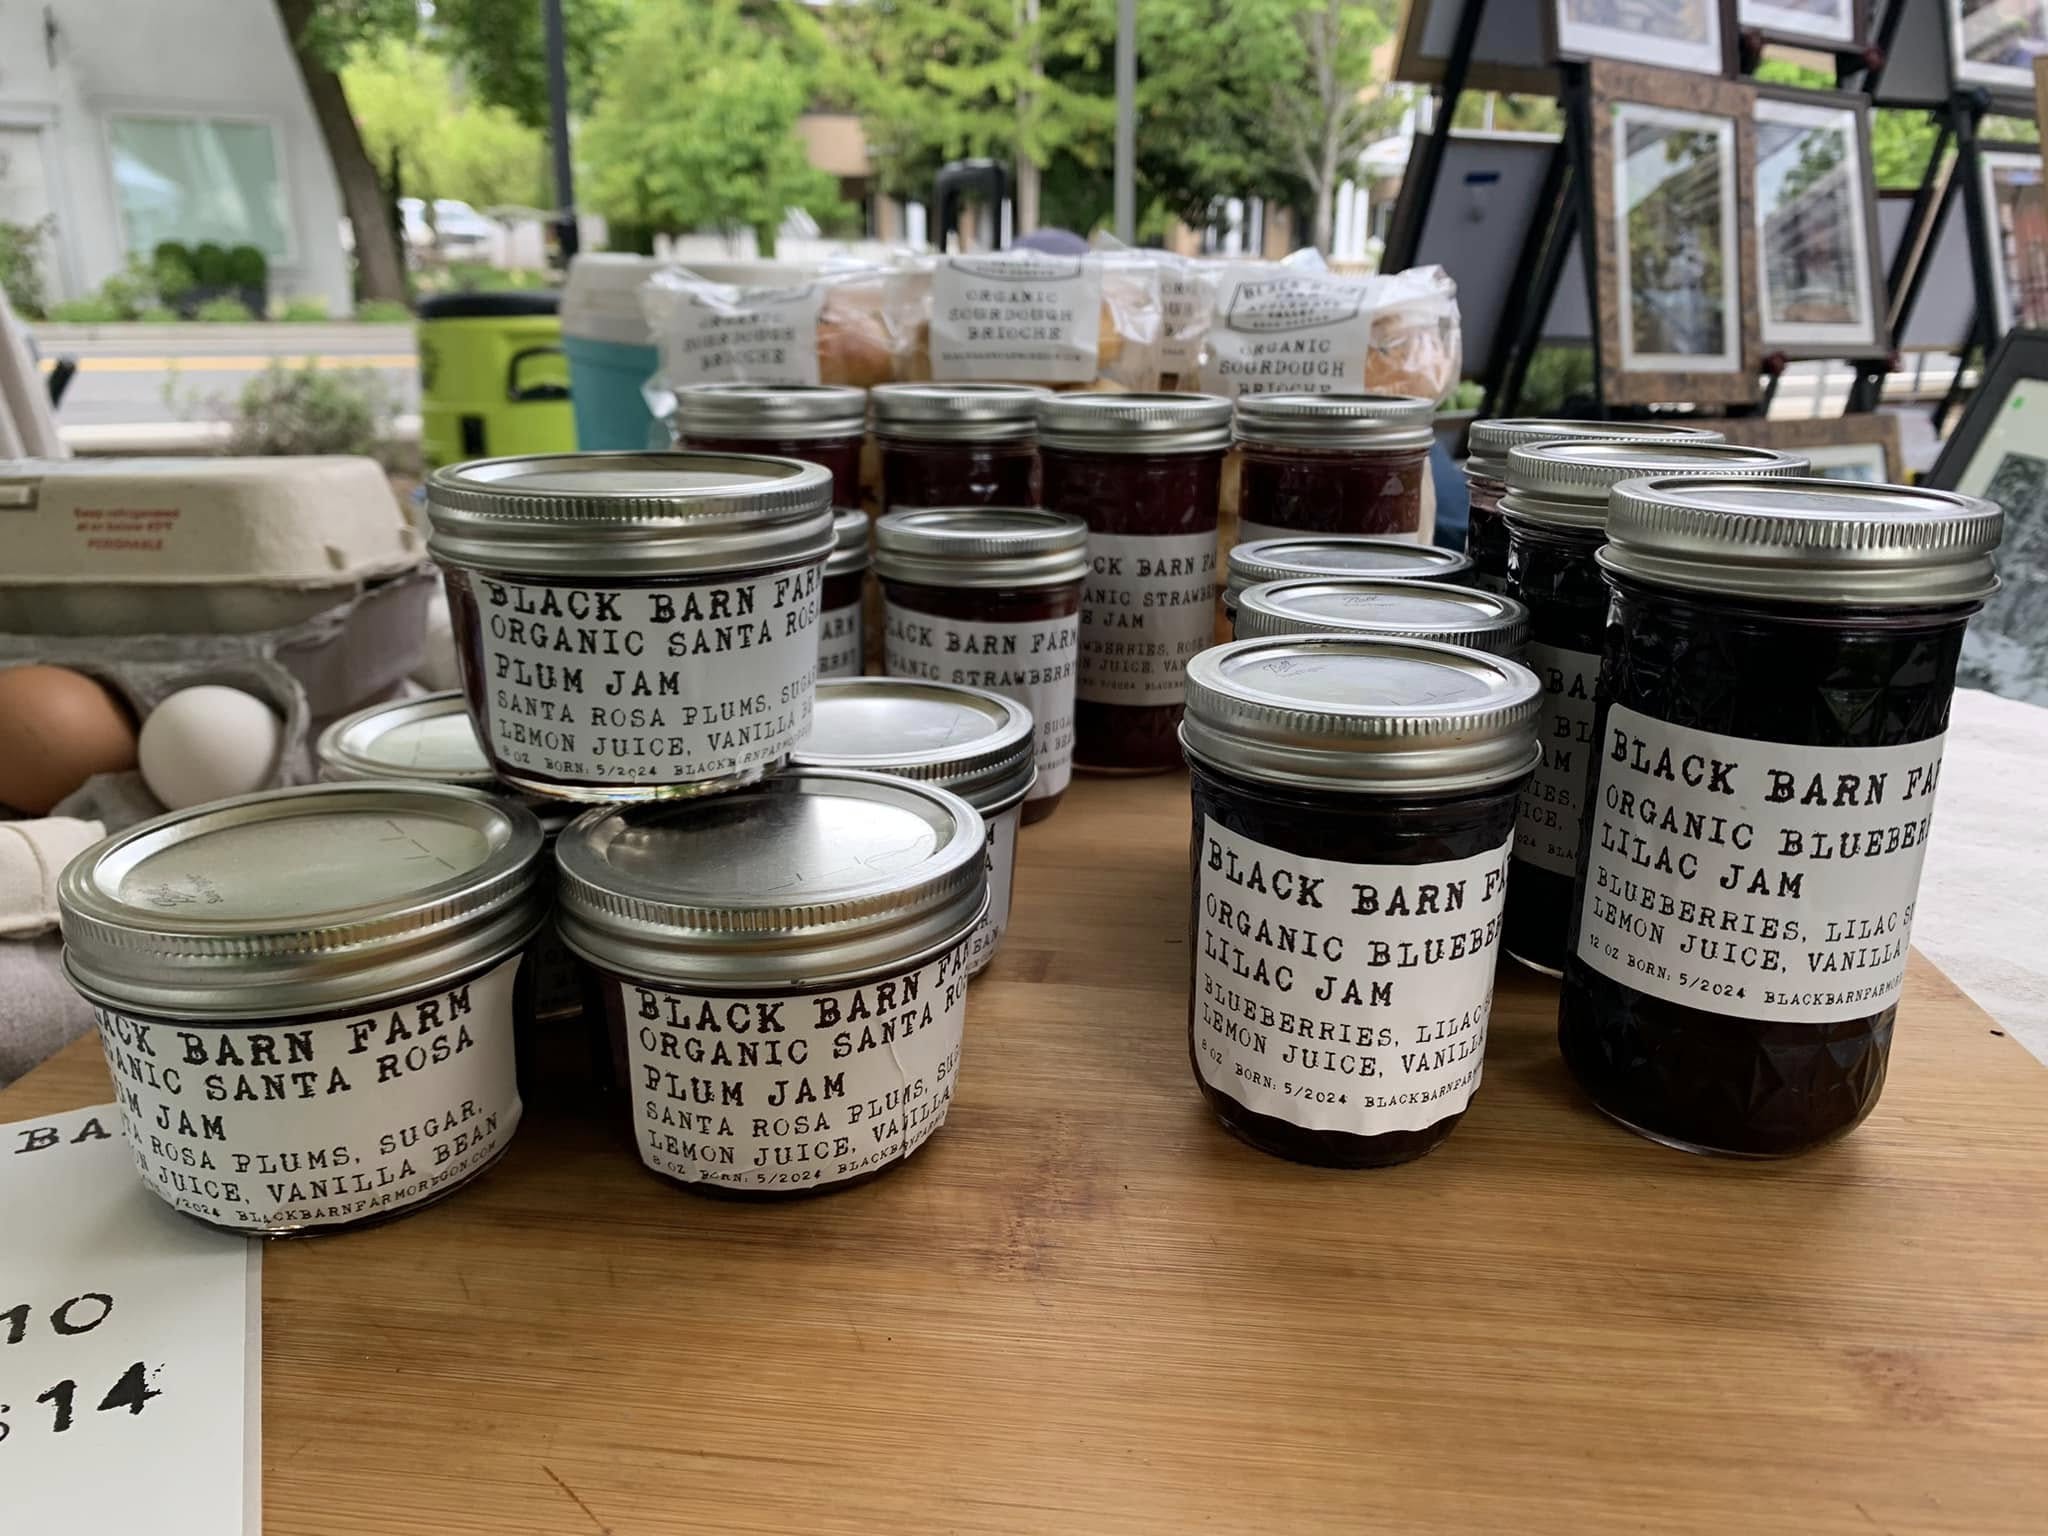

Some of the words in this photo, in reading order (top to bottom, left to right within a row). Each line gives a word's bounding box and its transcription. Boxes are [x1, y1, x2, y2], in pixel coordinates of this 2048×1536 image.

[1136, 557, 1195, 577] BARN
[480, 579, 622, 622] BLACK
[649, 585, 756, 624] BARN
[1103, 613, 1144, 628] JAM
[491, 614, 644, 656] ORGANIC
[668, 619, 772, 657] SANTA
[945, 631, 1017, 655] BARN
[495, 653, 584, 694] PLUM
[605, 670, 681, 696] JAM
[498, 690, 575, 724] SANTA
[591, 707, 666, 727] ROSA
[499, 719, 576, 752] LEMON
[592, 737, 692, 757] JUICE,
[708, 710, 795, 751] VANILLA
[513, 751, 531, 765] OZ
[597, 764, 658, 777] 5/2024
[1611, 728, 1738, 796] BLACK
[1765, 769, 1888, 806] BARN
[1607, 783, 1755, 851] ORGANIC
[1208, 837, 1324, 909] BLACK
[1351, 880, 1466, 917] BARN
[1601, 822, 1699, 880] LILAC
[1719, 864, 1804, 899] JAM
[1206, 892, 1344, 962] ORGANIC
[1597, 865, 1807, 944] BLUEBERRIES,
[1825, 912, 1897, 944] LILAC
[1593, 896, 1665, 946] LEMON
[1680, 934, 1788, 975] JUICE,
[1808, 943, 1902, 974] VANILLA
[1204, 930, 1293, 992] LILAC
[1315, 975, 1394, 1007] JAM
[1589, 934, 1600, 950] 12
[1604, 946, 1620, 960] OZ
[1627, 953, 1672, 982] BORN:
[1679, 972, 1746, 999] 5/2024
[178, 1031, 314, 1066] BARN
[346, 984, 473, 1055] FARM
[635, 986, 786, 1034] BLACK
[814, 971, 921, 1030] BARN
[1204, 973, 1400, 1048] BLUEBERRIES,
[1415, 1004, 1482, 1044] LILAC
[205, 1067, 351, 1102] SANTA
[377, 1025, 474, 1083] ROSA
[640, 1027, 809, 1067] ORGANIC
[832, 1009, 934, 1060] SANTA
[1201, 1002, 1267, 1054] LEMON
[1282, 1044, 1384, 1079] JUICE,
[643, 1063, 744, 1108] PLUM
[768, 1072, 846, 1108] JAM
[1210, 1050, 1223, 1065] OZ
[1235, 1062, 1278, 1091] BORN:
[1284, 1082, 1348, 1105] 5/2024
[152, 1136, 216, 1171] ROSA
[231, 1145, 361, 1175] PLUMS,
[379, 1099, 484, 1156] SUGAR,
[156, 1102, 227, 1142] JAM
[646, 1100, 735, 1137] SANTA
[752, 1112, 830, 1138] ROSA
[648, 1128, 735, 1166] LEMON
[753, 1136, 857, 1168] JUICE,
[158, 1168, 250, 1205] JUICE,
[267, 1161, 417, 1205] VANILLA
[433, 1111, 499, 1166] BEAN
[757, 1168, 823, 1185] 5/2024
